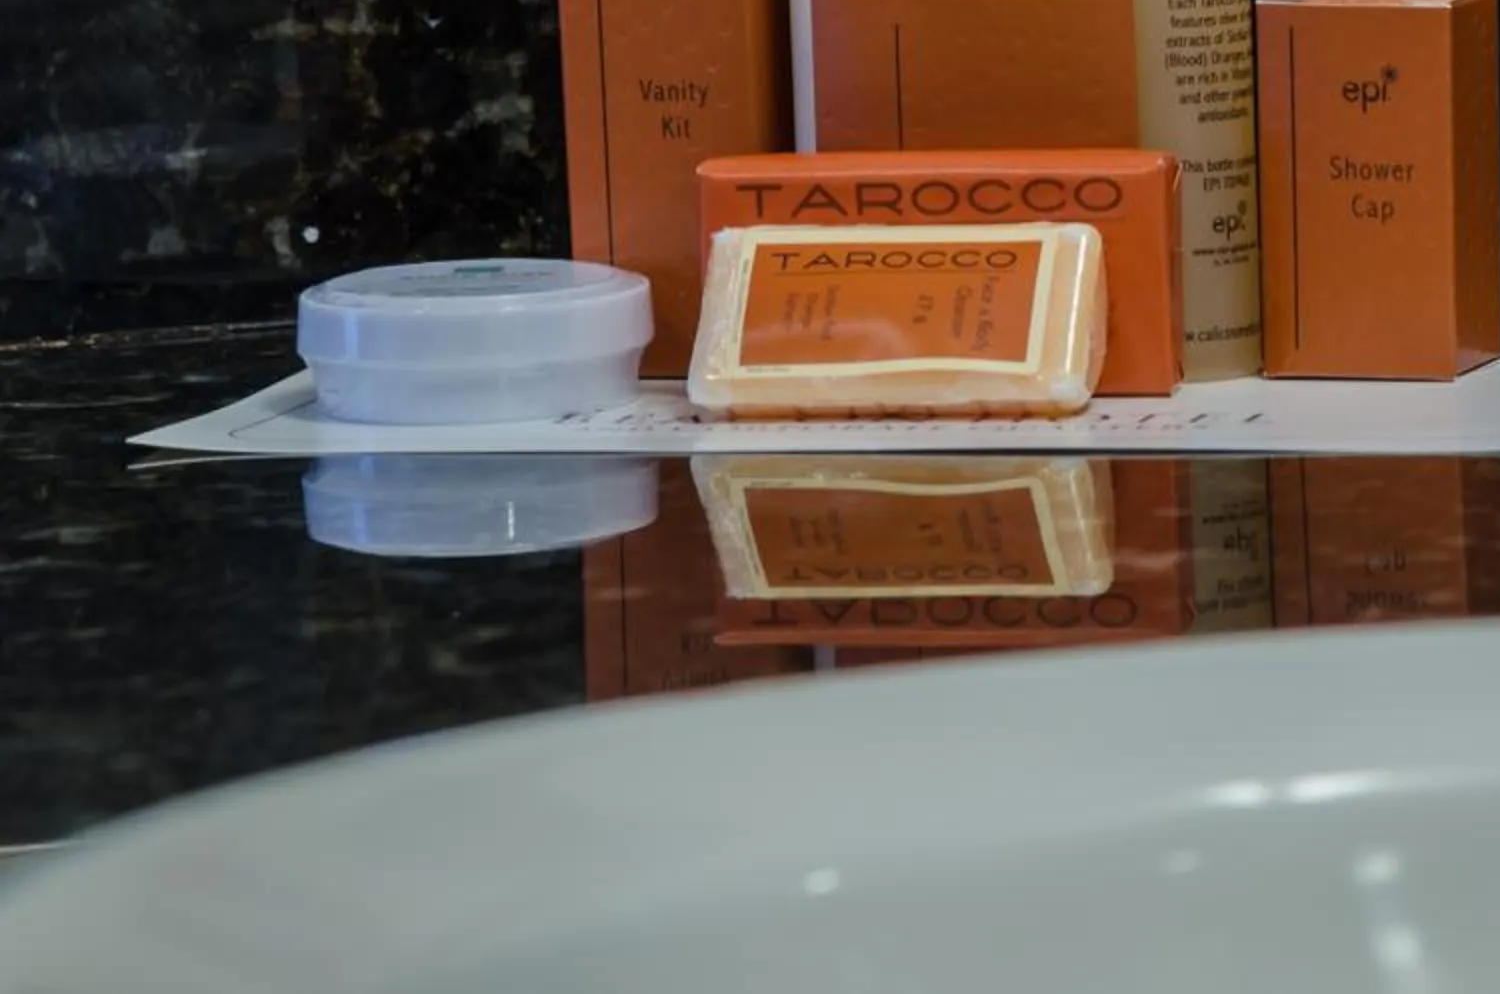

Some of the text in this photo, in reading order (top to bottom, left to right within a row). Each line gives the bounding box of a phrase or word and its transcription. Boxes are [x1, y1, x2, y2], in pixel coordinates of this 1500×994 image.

[639, 78, 709, 109] Vanity
[661, 115, 691, 139] Kit
[1329, 155, 1415, 183] Shower
[736, 176, 1123, 219] TAROCCO
[1351, 192, 1394, 226] Cap
[771, 249, 1018, 270] TAROCCO
